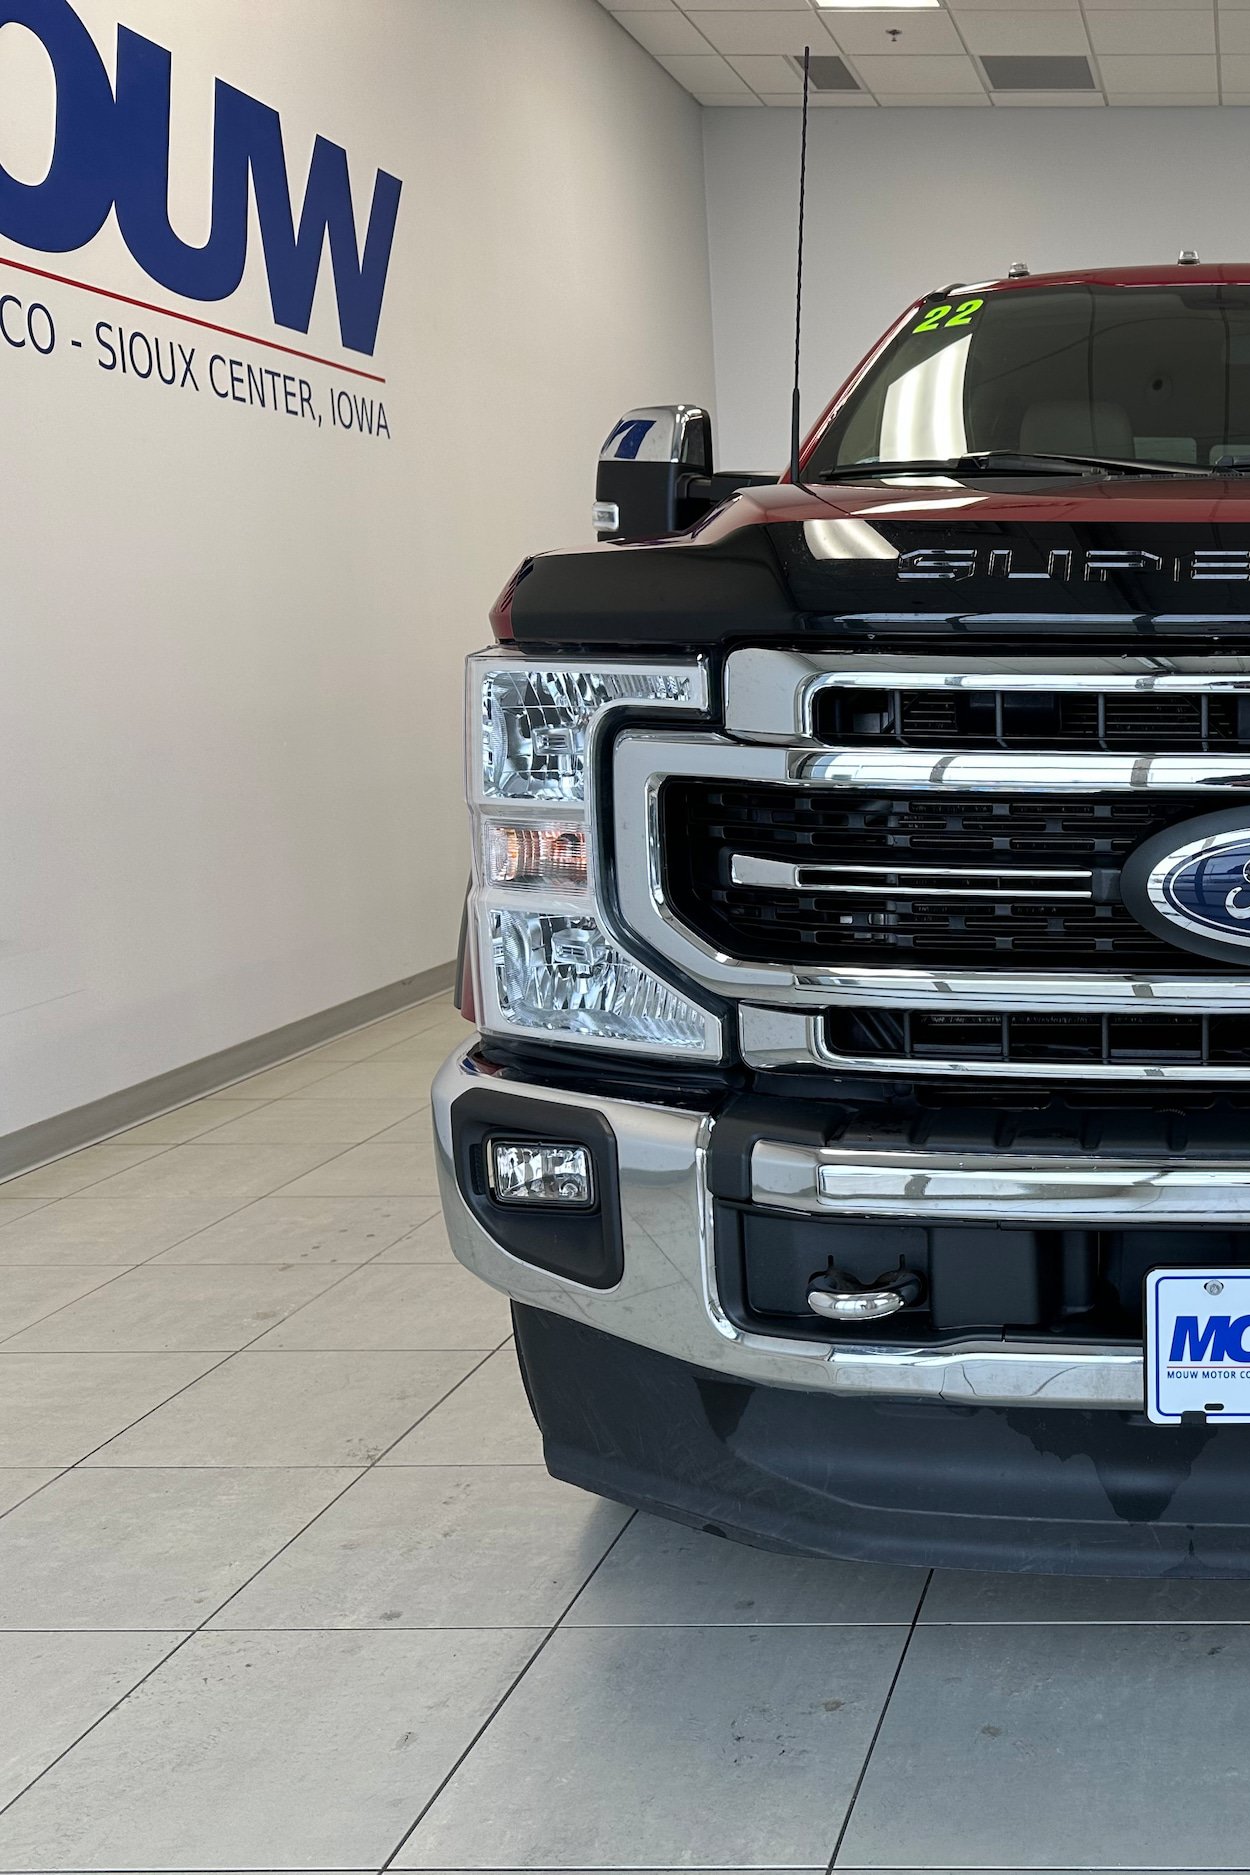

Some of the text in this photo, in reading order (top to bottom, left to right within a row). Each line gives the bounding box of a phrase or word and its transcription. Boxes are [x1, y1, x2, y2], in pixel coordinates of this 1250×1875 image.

[912, 299, 984, 334] 22
[0, 294, 56, 355] CO
[95, 321, 200, 392] SIOUX
[209, 354, 322, 428] CENTER,
[330, 387, 391, 440] IOWA
[1167, 1370, 1198, 1379] MOUW
[1202, 1370, 1236, 1379] MOTOR
